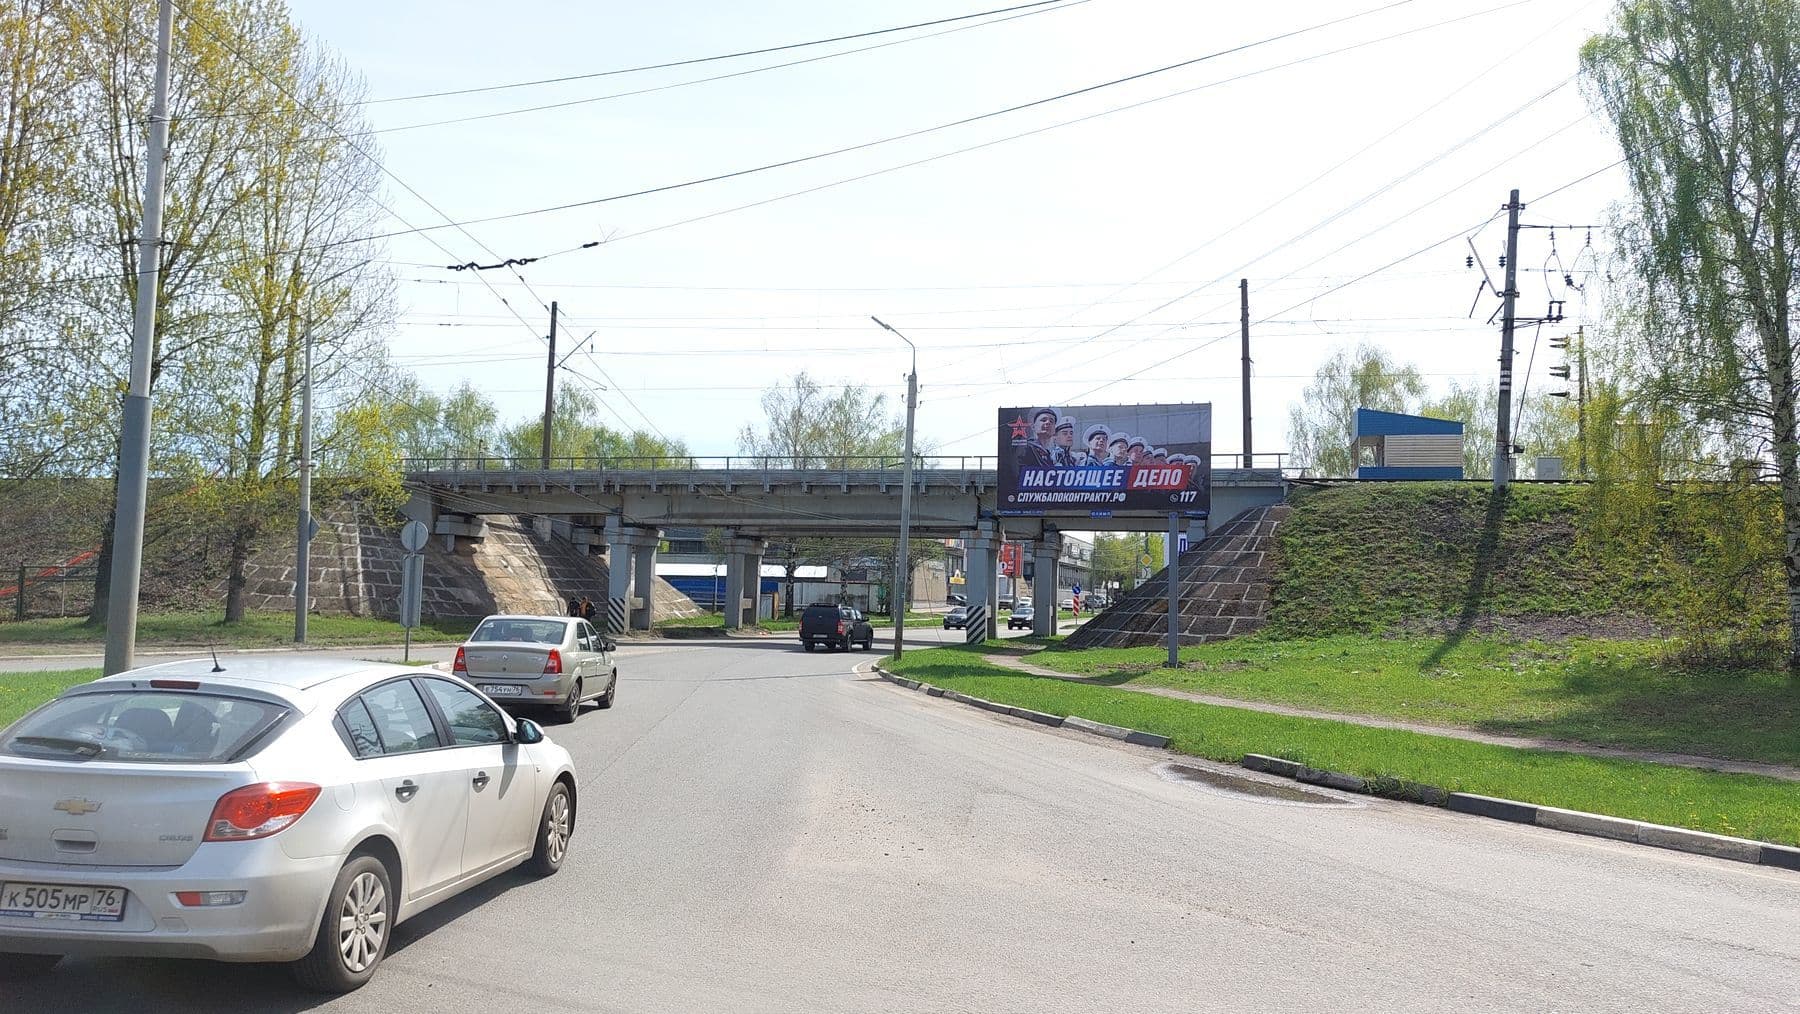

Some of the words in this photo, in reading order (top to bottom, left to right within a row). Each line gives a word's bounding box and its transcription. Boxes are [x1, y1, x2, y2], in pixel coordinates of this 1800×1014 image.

[1022, 469, 1125, 488] НАСТОЯЩЕЕ
[1132, 468, 1183, 488] ДЕЛО
[1017, 491, 1127, 503] СЛУЖБАПОКОНТРАКТУ.РФ
[1179, 490, 1197, 503] 117
[96, 890, 116, 906] 76
